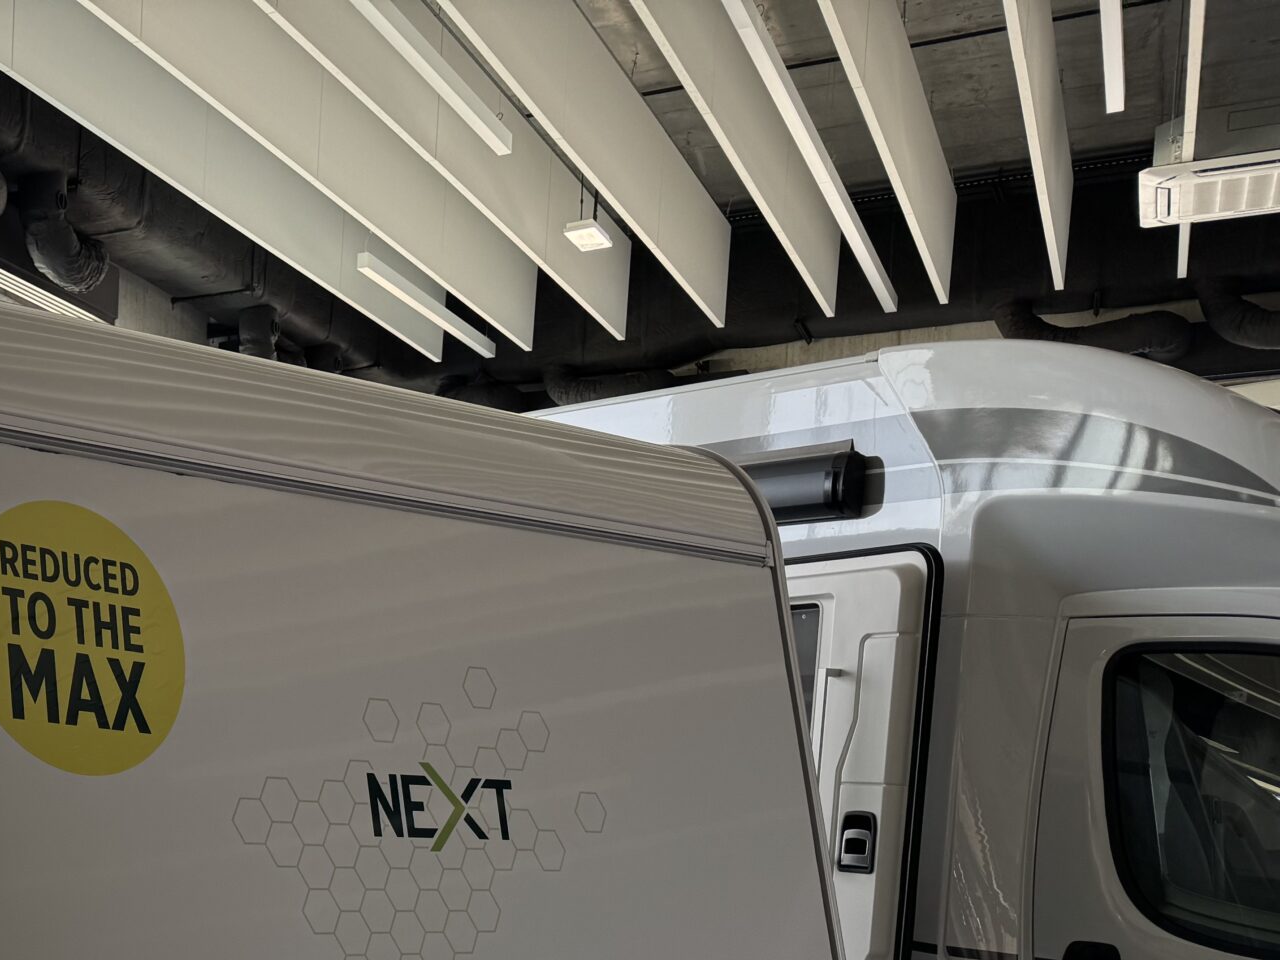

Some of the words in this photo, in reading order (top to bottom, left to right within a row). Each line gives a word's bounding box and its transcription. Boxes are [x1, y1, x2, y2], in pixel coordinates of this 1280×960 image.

[1, 586, 57, 640] TO
[66, 597, 144, 654] THE
[7, 642, 152, 735] MAX
[366, 761, 513, 852] NEXT
